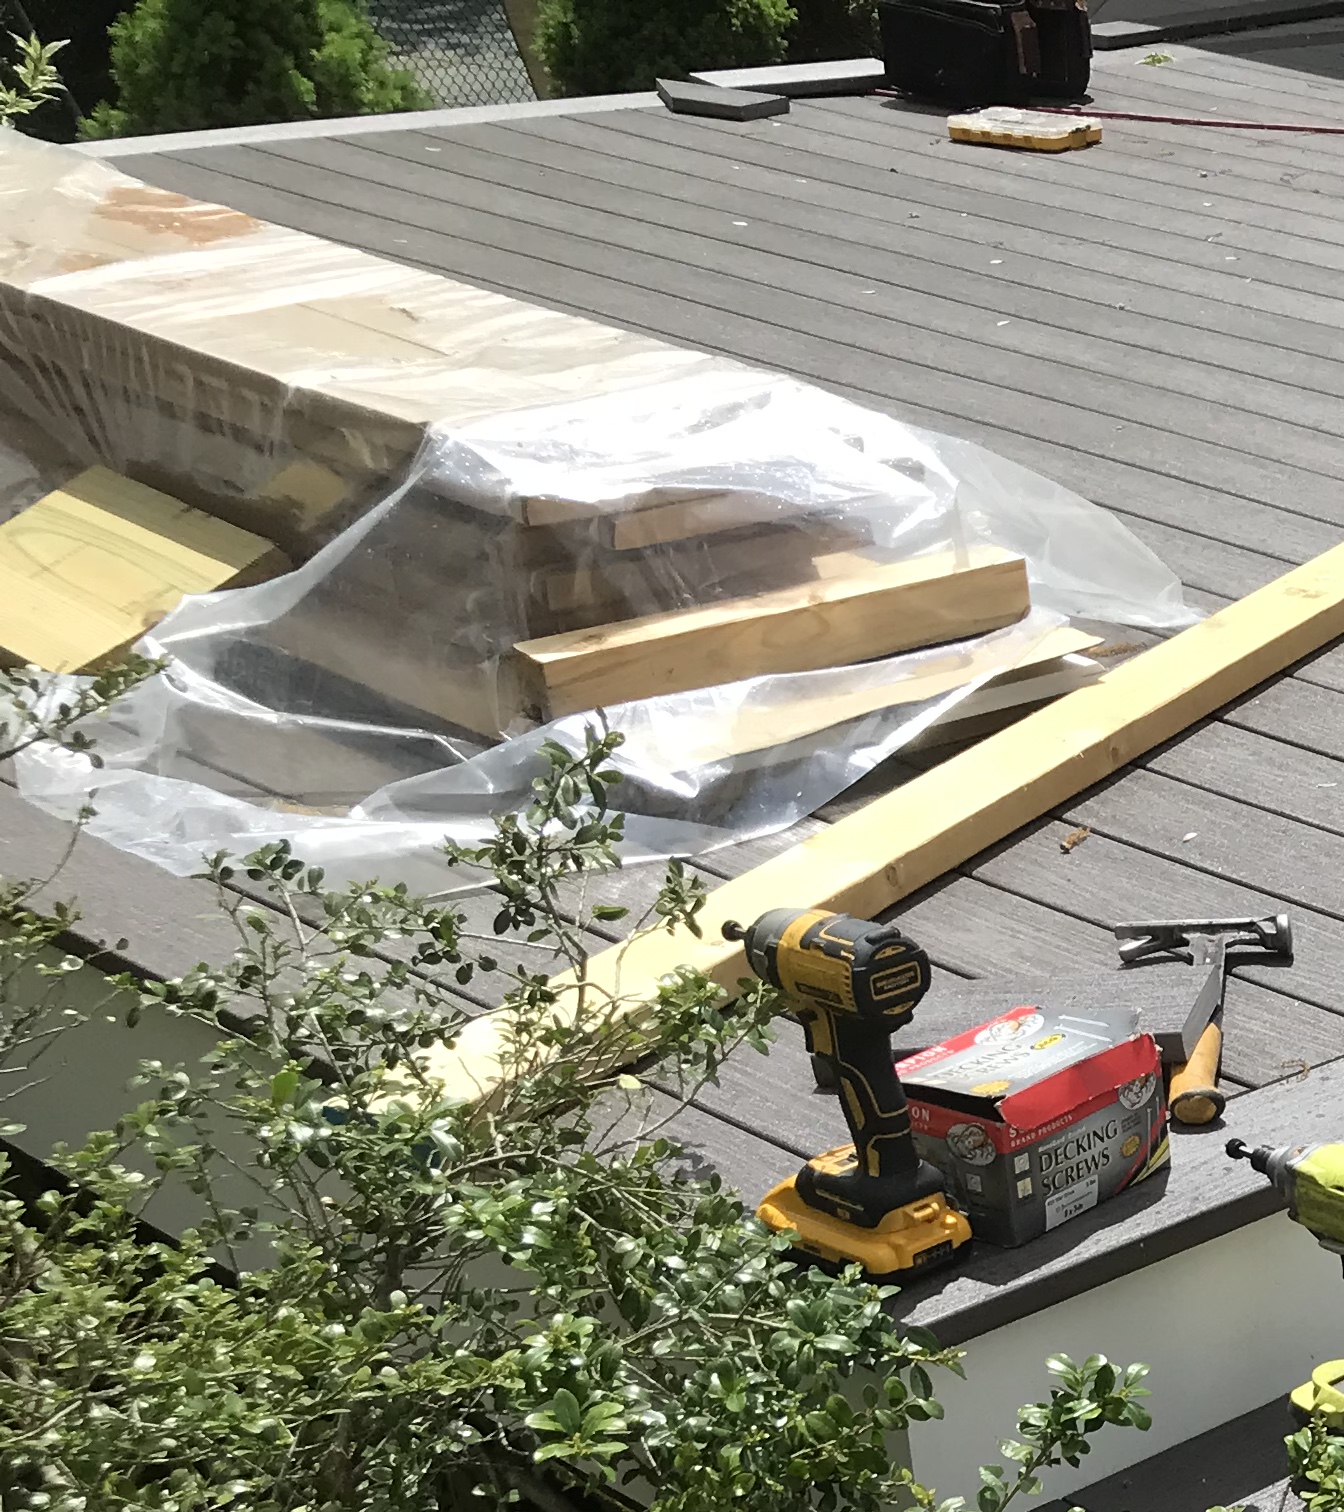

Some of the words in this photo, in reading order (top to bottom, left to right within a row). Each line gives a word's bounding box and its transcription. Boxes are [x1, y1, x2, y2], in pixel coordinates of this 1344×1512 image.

[1038, 1114, 1073, 1137] PRODUCTS
[1039, 1119, 1119, 1174] DECKING
[1041, 1147, 1111, 1197] SCREWS
